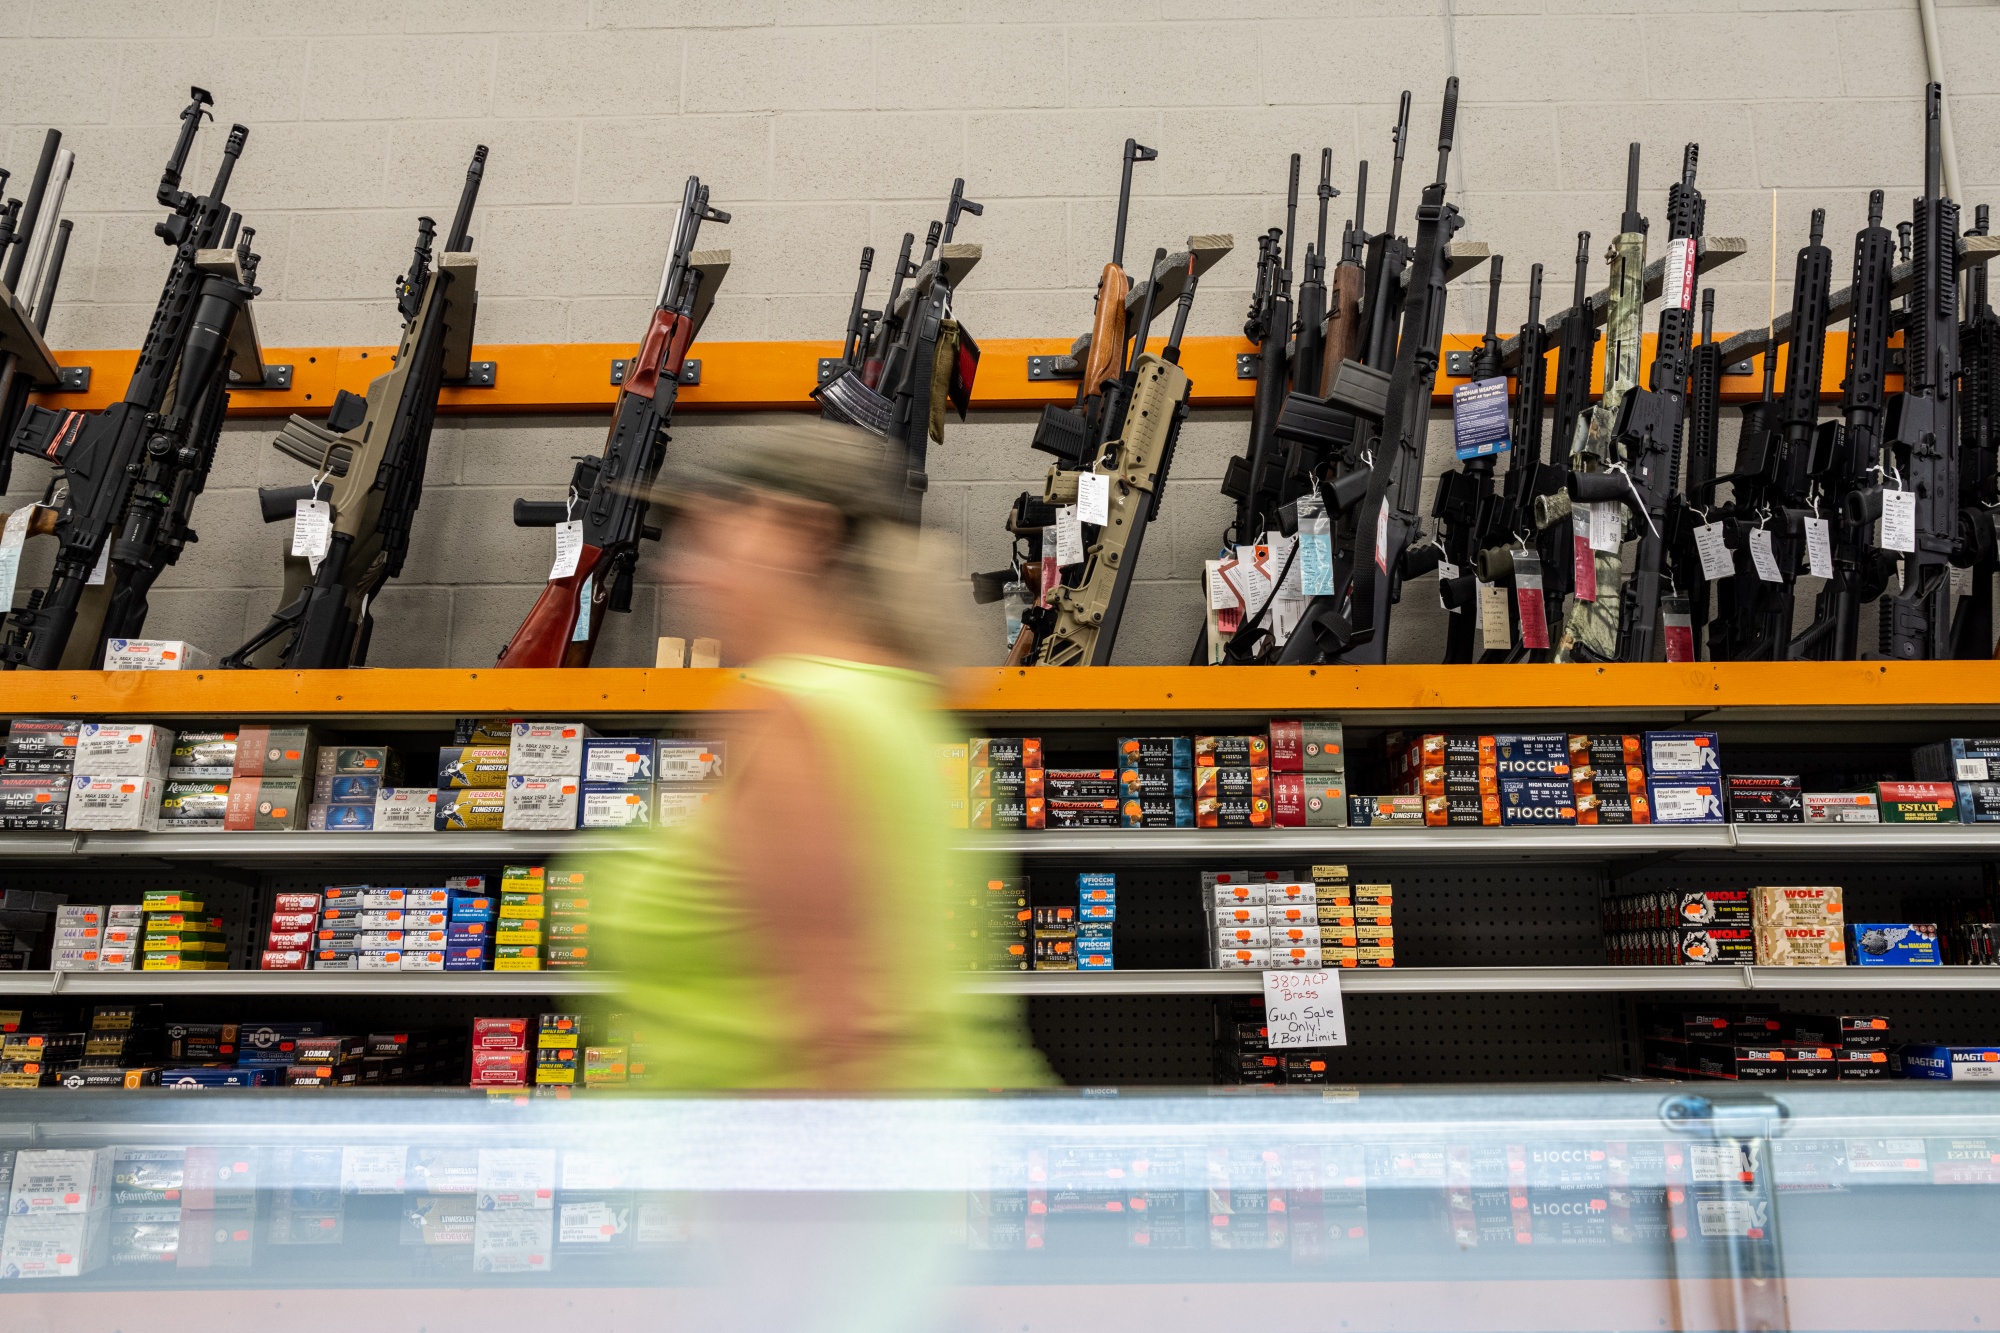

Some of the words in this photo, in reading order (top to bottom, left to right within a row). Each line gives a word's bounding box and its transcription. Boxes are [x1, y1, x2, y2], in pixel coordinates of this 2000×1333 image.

[13, 723, 63, 731] WINCHESTER
[1897, 803, 1943, 812] ESTATE
[1506, 807, 1571, 819] FIOCCH
[1705, 891, 1747, 900] WOLF
[1784, 890, 1825, 898] WOLF
[1707, 929, 1751, 939] WOLF
[1785, 929, 1826, 938] WOLF
[1270, 974, 1300, 989] 380
[1303, 972, 1328, 987] ACP
[1280, 988, 1319, 1002] Brass
[1268, 1007, 1298, 1022] Gun
[1303, 1006, 1334, 1019] Sale
[1288, 1018, 1321, 1037] Only!
[1854, 1020, 1872, 1029] Blaz
[249, 1033, 281, 1042] PPU
[1270, 1032, 1279, 1045] 1
[1280, 1032, 1302, 1044] Box
[1306, 1031, 1338, 1043] Limit
[1748, 1051, 1770, 1059] Blaze
[1798, 1051, 1819, 1060] Blaz
[1850, 1052, 1872, 1060] Blaze
[1907, 1056, 1945, 1069] MAGTECH
